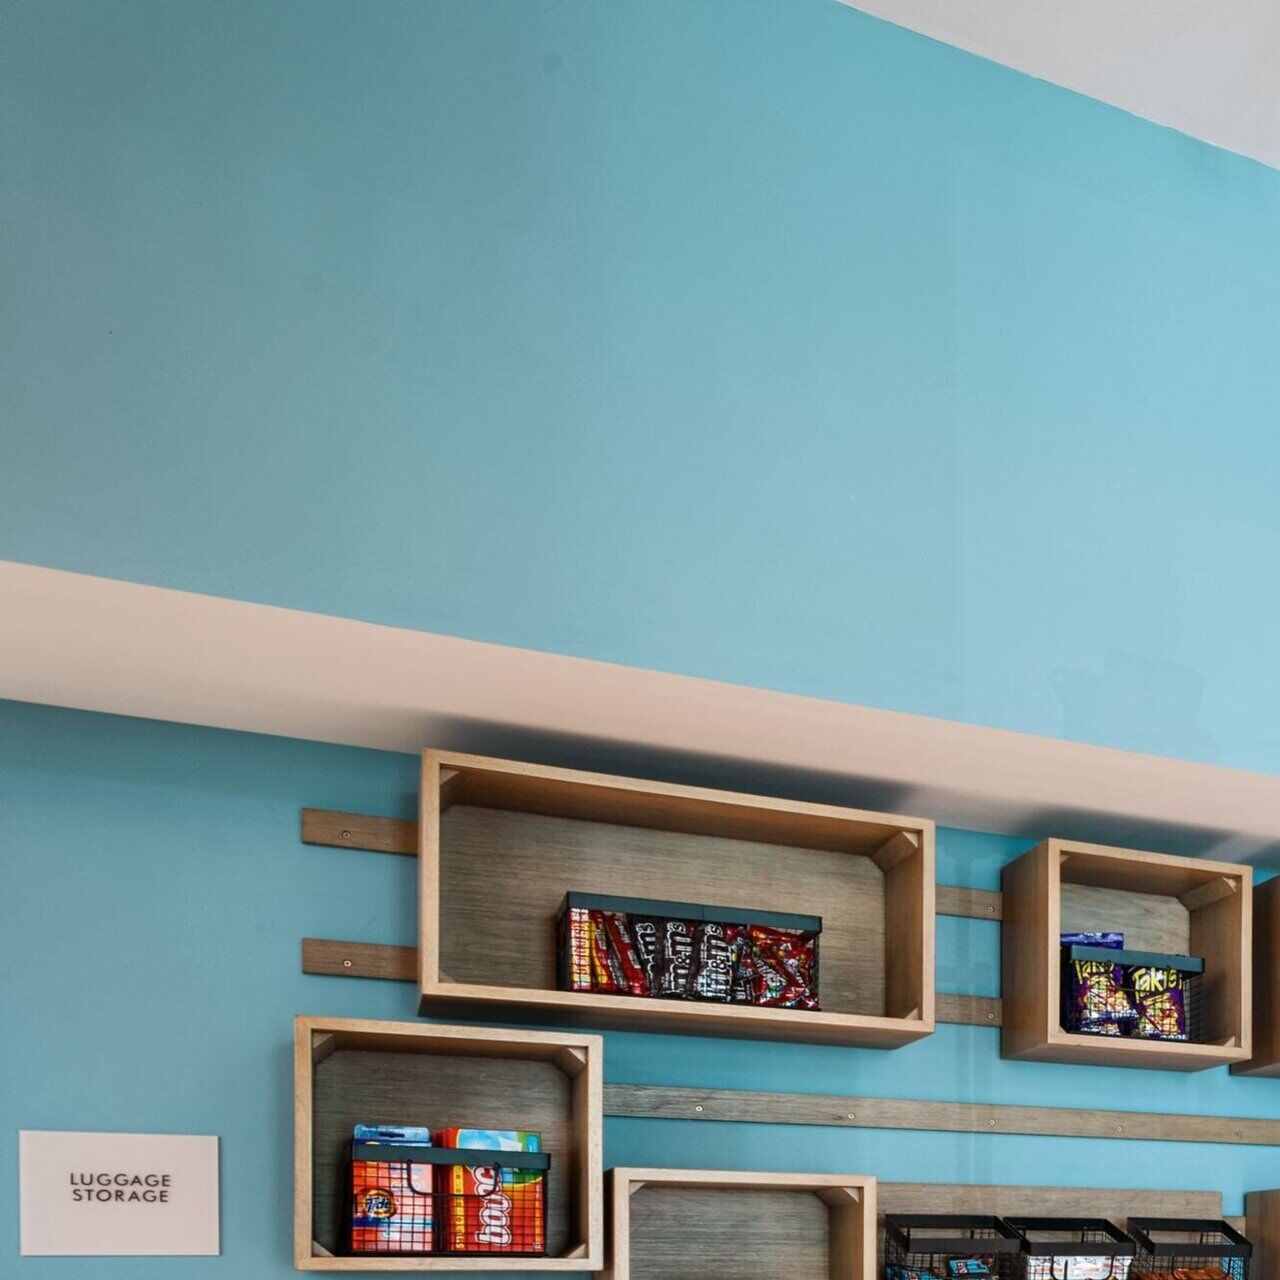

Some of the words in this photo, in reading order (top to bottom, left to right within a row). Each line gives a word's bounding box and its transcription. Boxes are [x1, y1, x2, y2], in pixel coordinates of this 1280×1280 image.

[1131, 966, 1178, 1002] Takis
[70, 1173, 171, 1187] LUGGAGE
[73, 1189, 169, 1203] STORAGE
[474, 1164, 512, 1246] bounc
